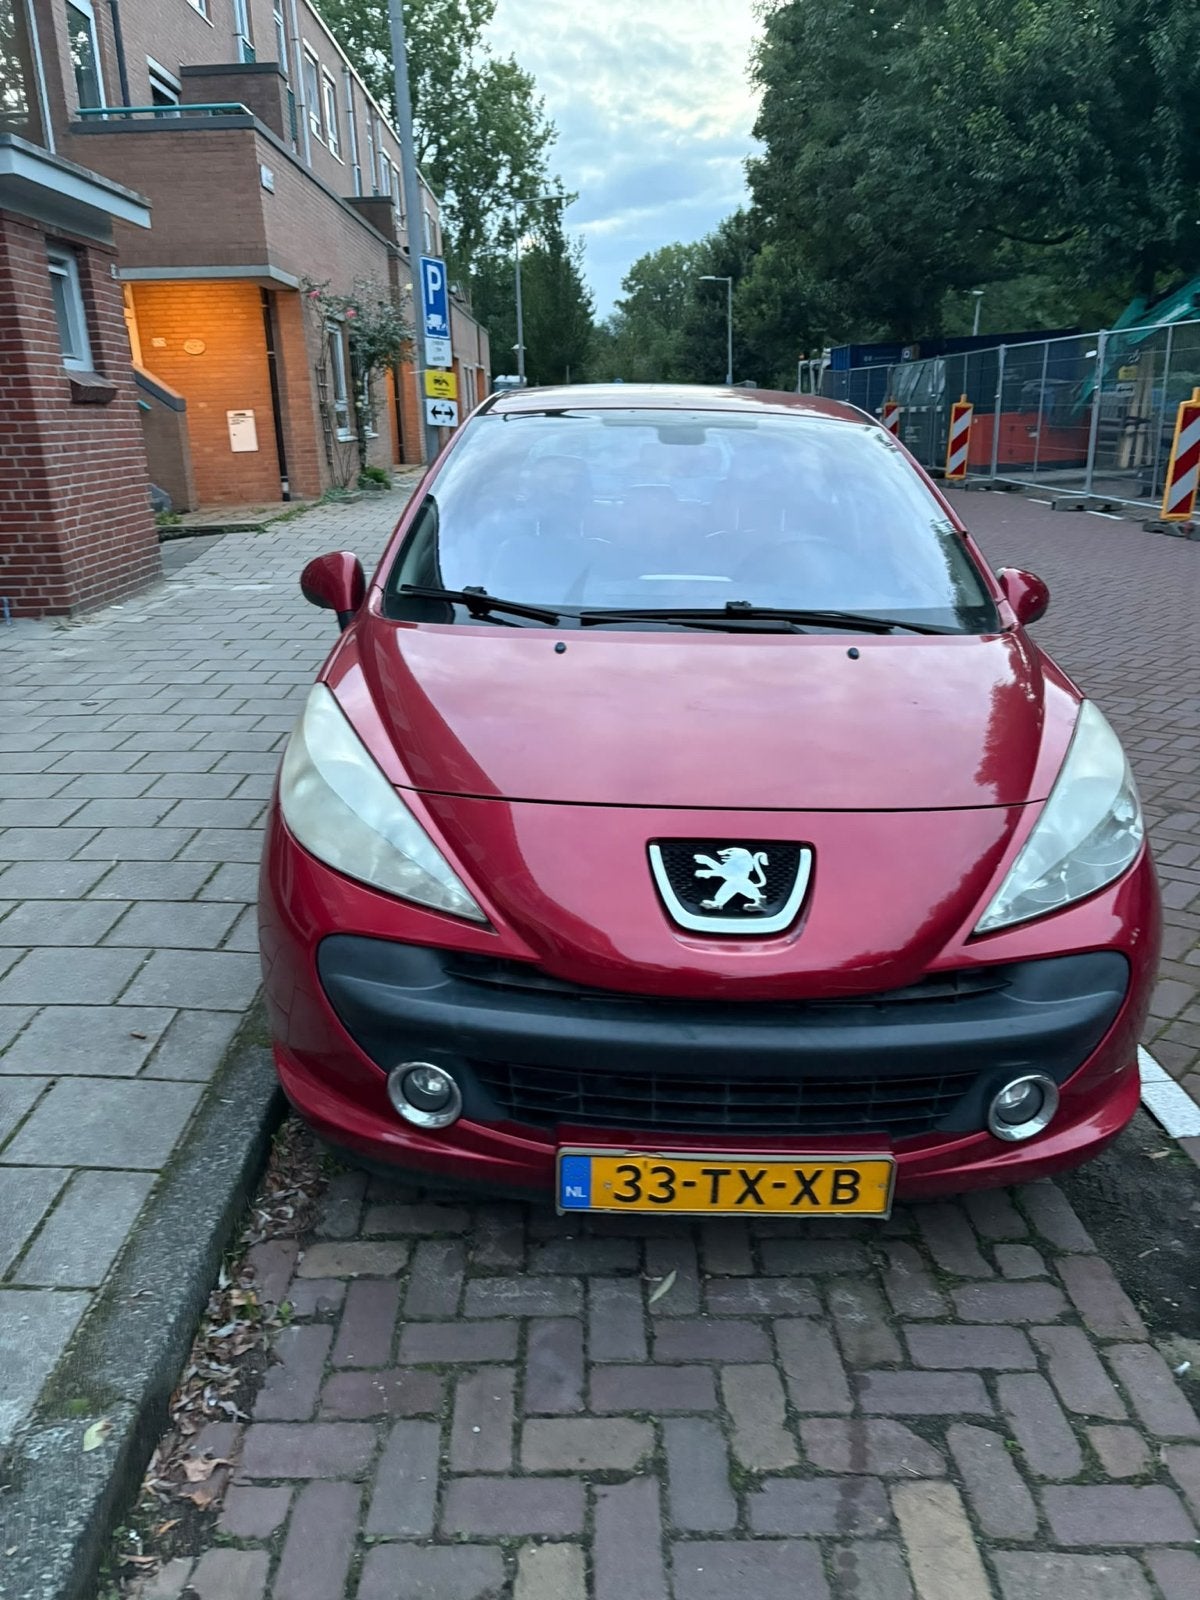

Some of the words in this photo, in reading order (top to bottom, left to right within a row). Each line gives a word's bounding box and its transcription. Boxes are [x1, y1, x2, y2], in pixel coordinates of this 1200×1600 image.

[427, 264, 442, 305] P
[565, 1186, 587, 1198] NL
[613, 1165, 861, 1206] 33-TX-XB
